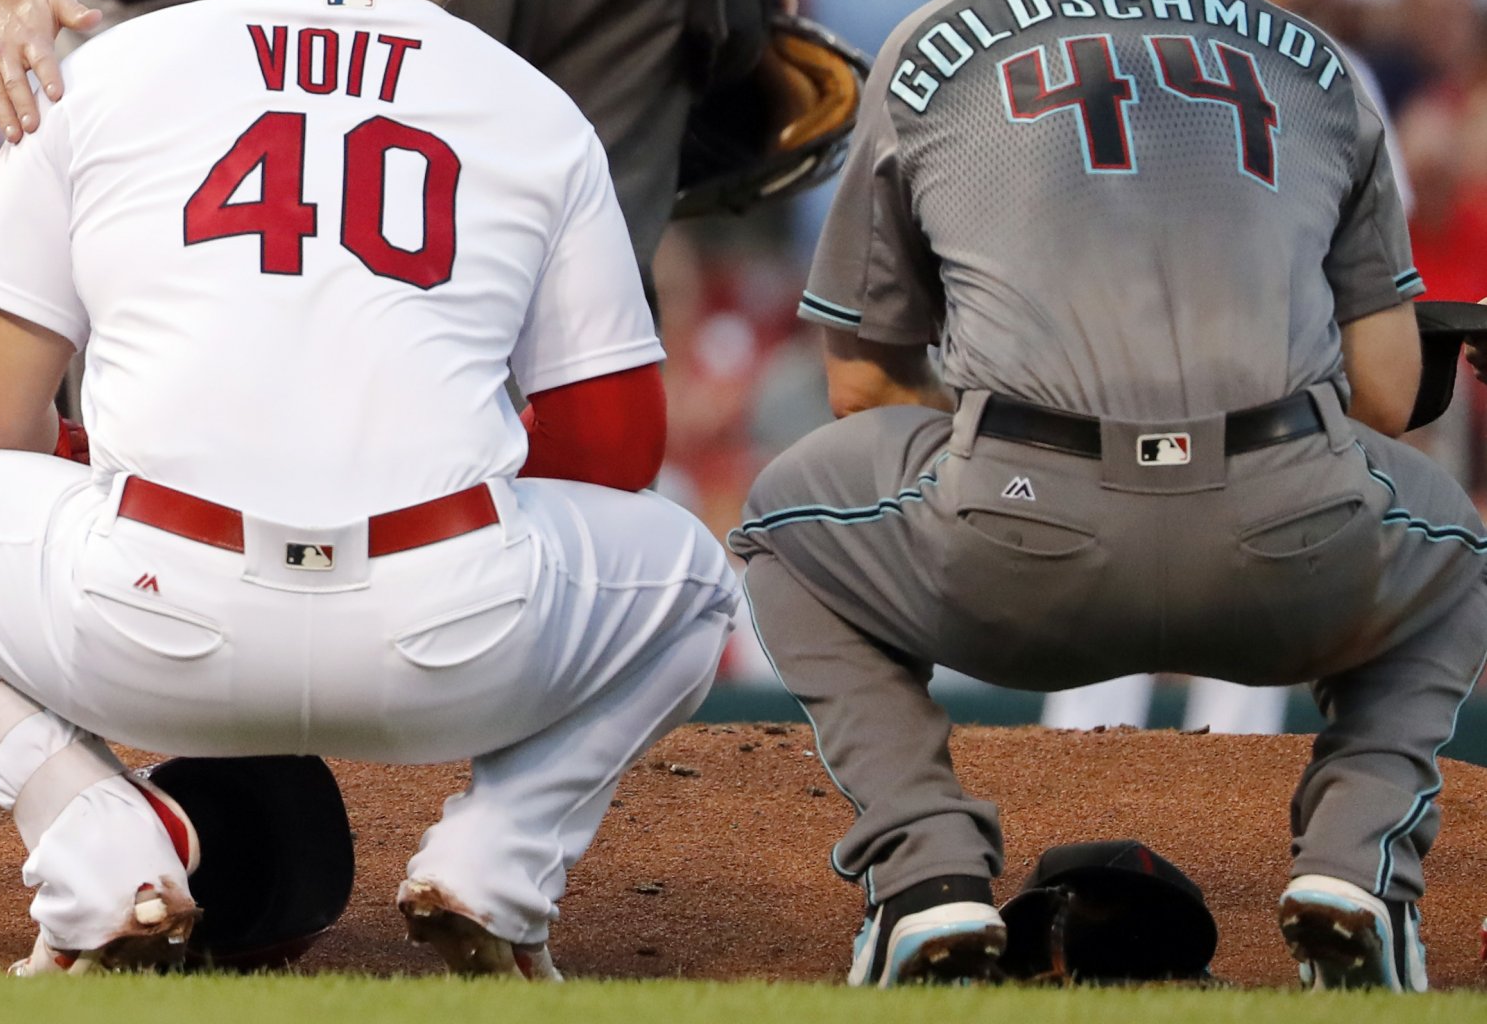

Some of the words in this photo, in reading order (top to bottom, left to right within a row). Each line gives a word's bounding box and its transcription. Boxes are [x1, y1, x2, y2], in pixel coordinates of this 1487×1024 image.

[247, 24, 421, 103] VOIT
[995, 33, 1281, 193] 44
[183, 110, 462, 291] 40
